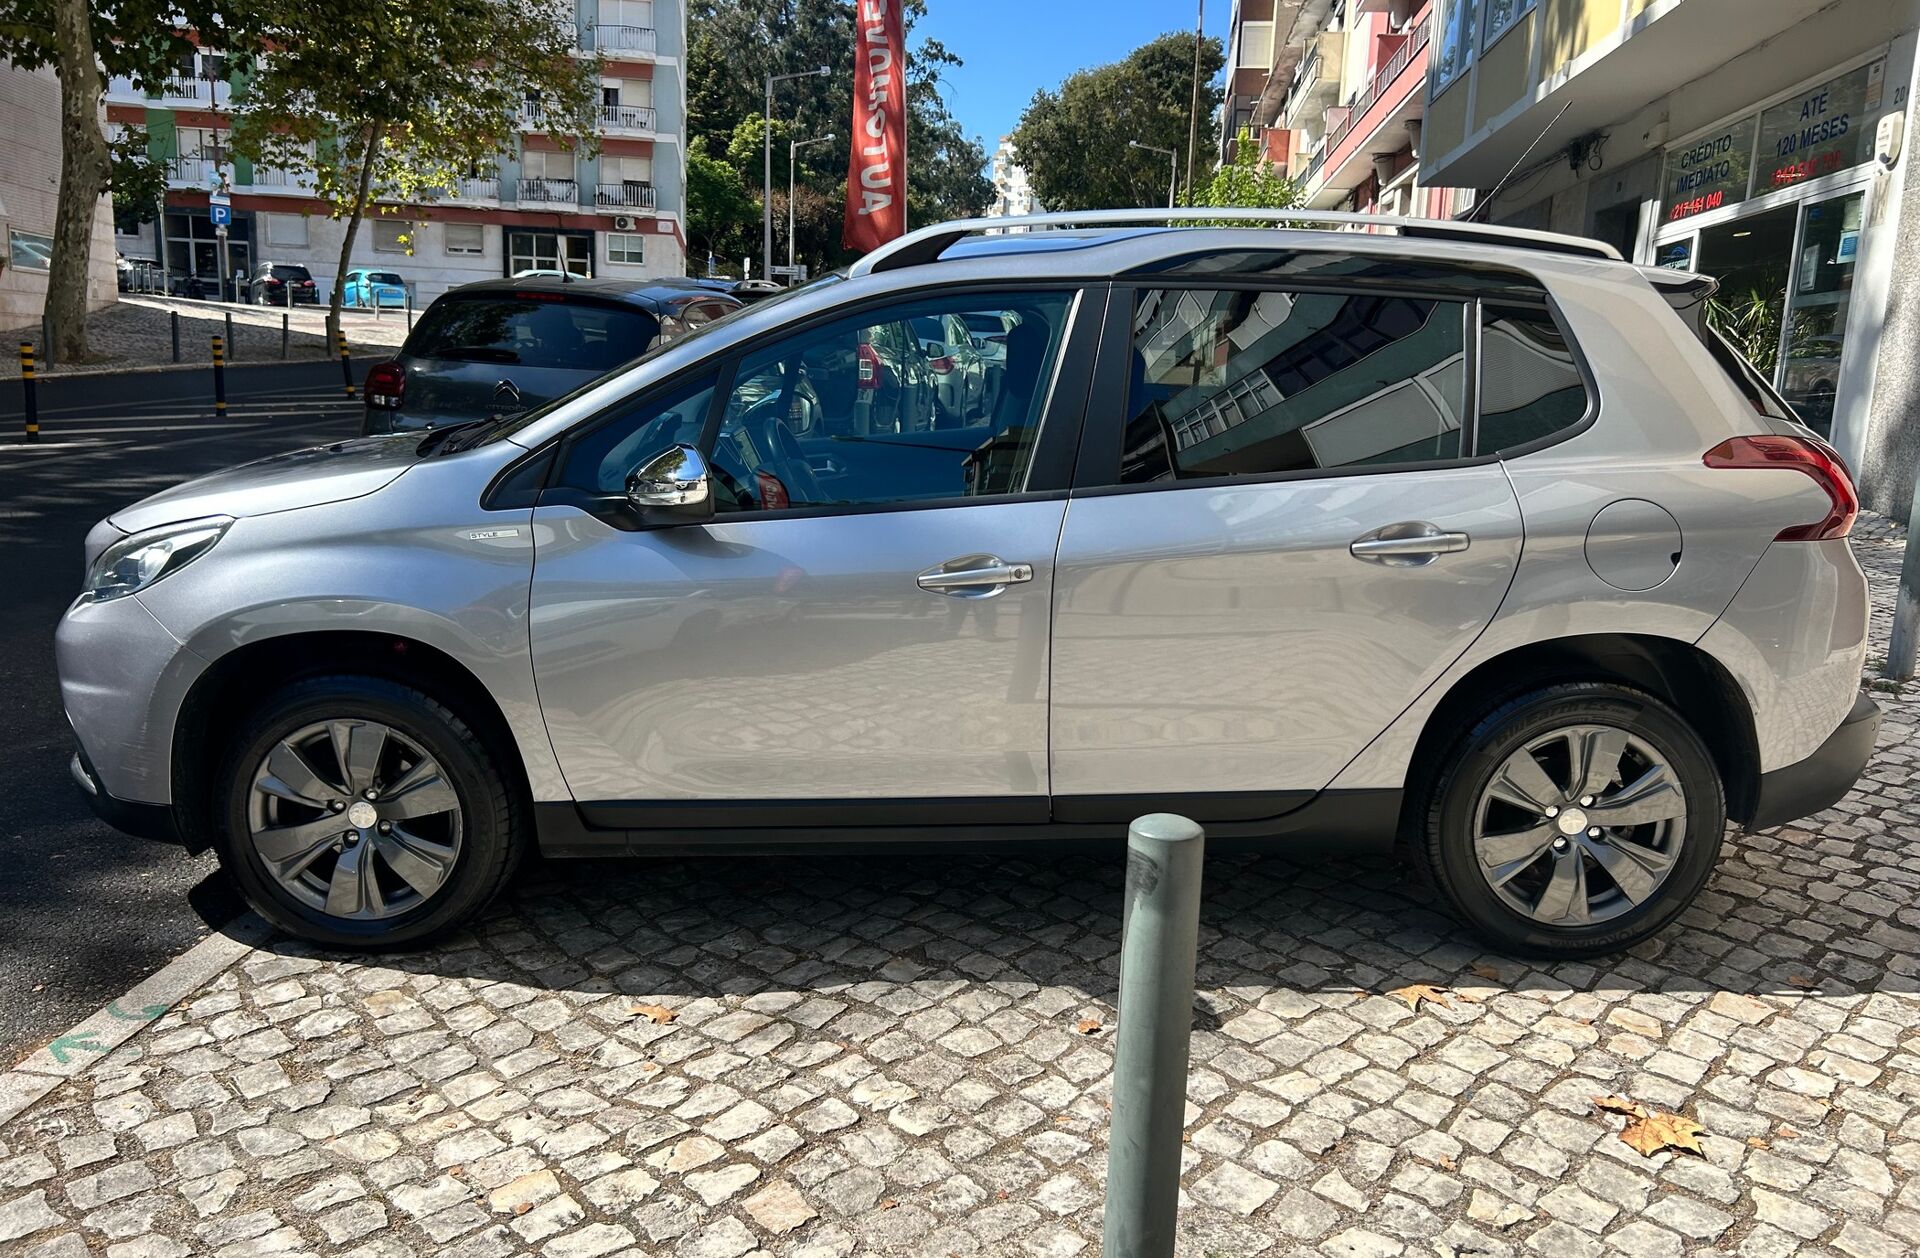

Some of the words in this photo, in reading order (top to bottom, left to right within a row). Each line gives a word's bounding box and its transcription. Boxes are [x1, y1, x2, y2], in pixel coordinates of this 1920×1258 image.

[1800, 87, 1828, 121] ATÉ
[1681, 134, 1732, 169] CRÉDITO
[1776, 133, 1796, 158] 120
[1800, 113, 1849, 149] MESES
[1676, 159, 1730, 194] IMEDIATO
[215, 207, 226, 222] P
[1706, 190, 1723, 210] 040
